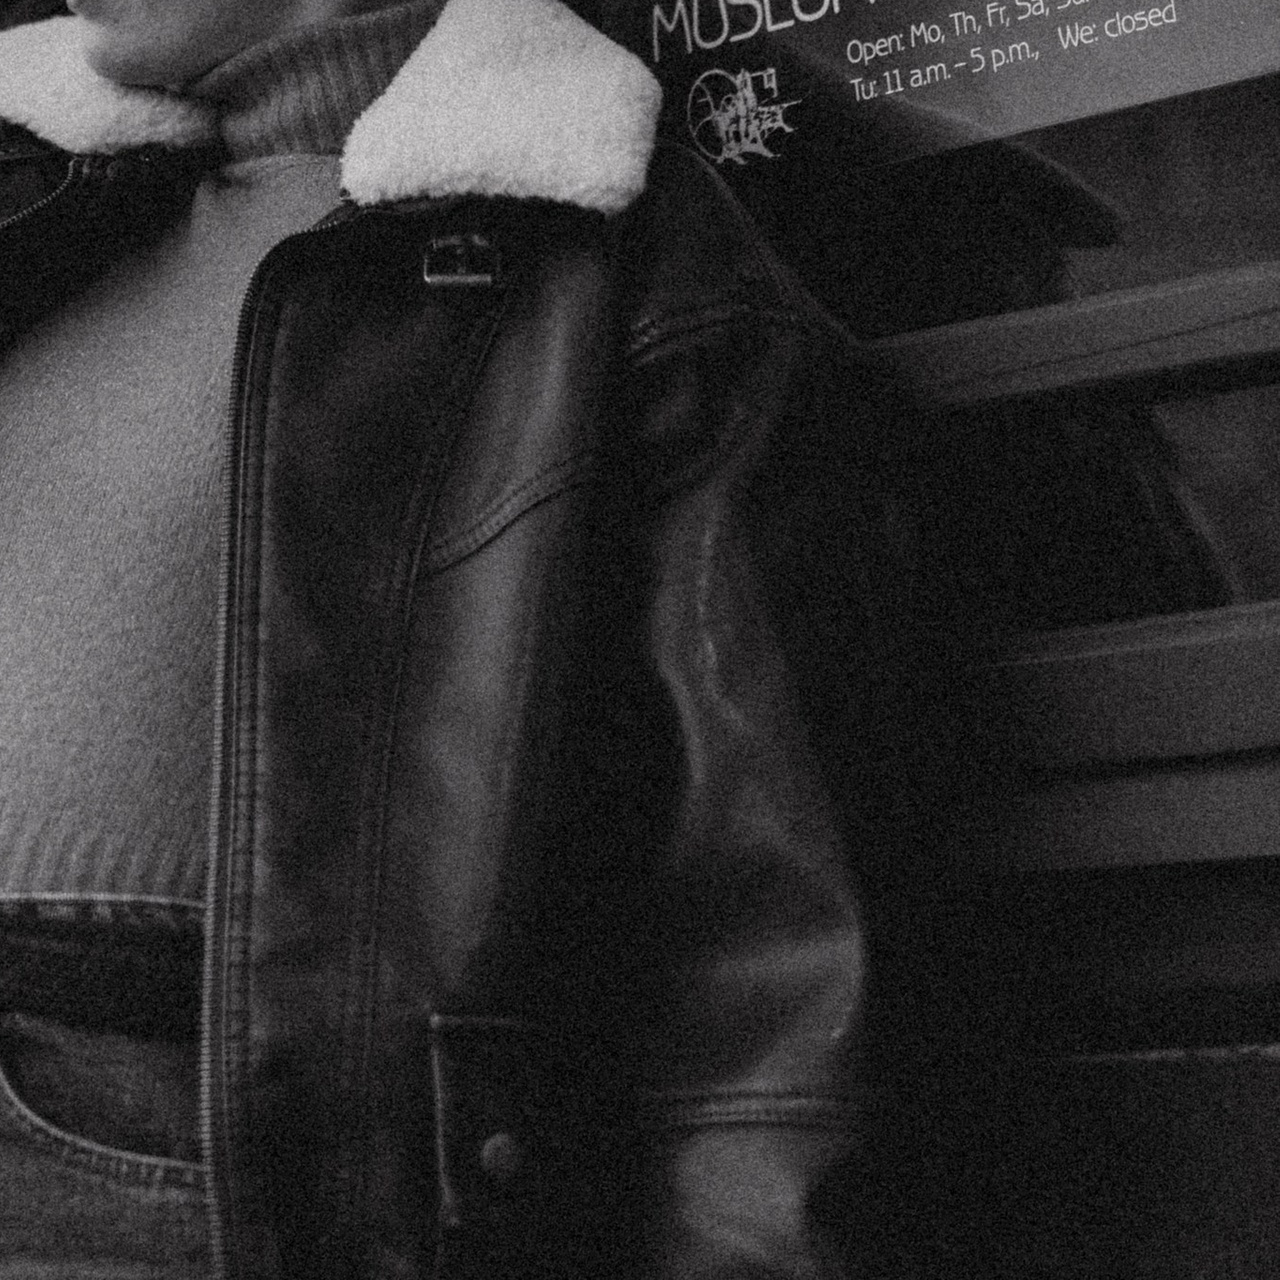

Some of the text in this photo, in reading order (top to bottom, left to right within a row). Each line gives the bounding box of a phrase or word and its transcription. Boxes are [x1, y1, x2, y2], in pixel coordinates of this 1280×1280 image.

[845, 32, 906, 67] Open:
[909, 21, 947, 49] Mo,
[948, 10, 983, 37] Th,
[985, 1, 1011, 28] Fr,
[848, 76, 879, 103] Tu:
[882, 68, 906, 96] 11
[909, 61, 953, 89] a.m.
[969, 46, 987, 74] 5
[990, 40, 1041, 74] p.m.,
[1056, 21, 1100, 51] We:
